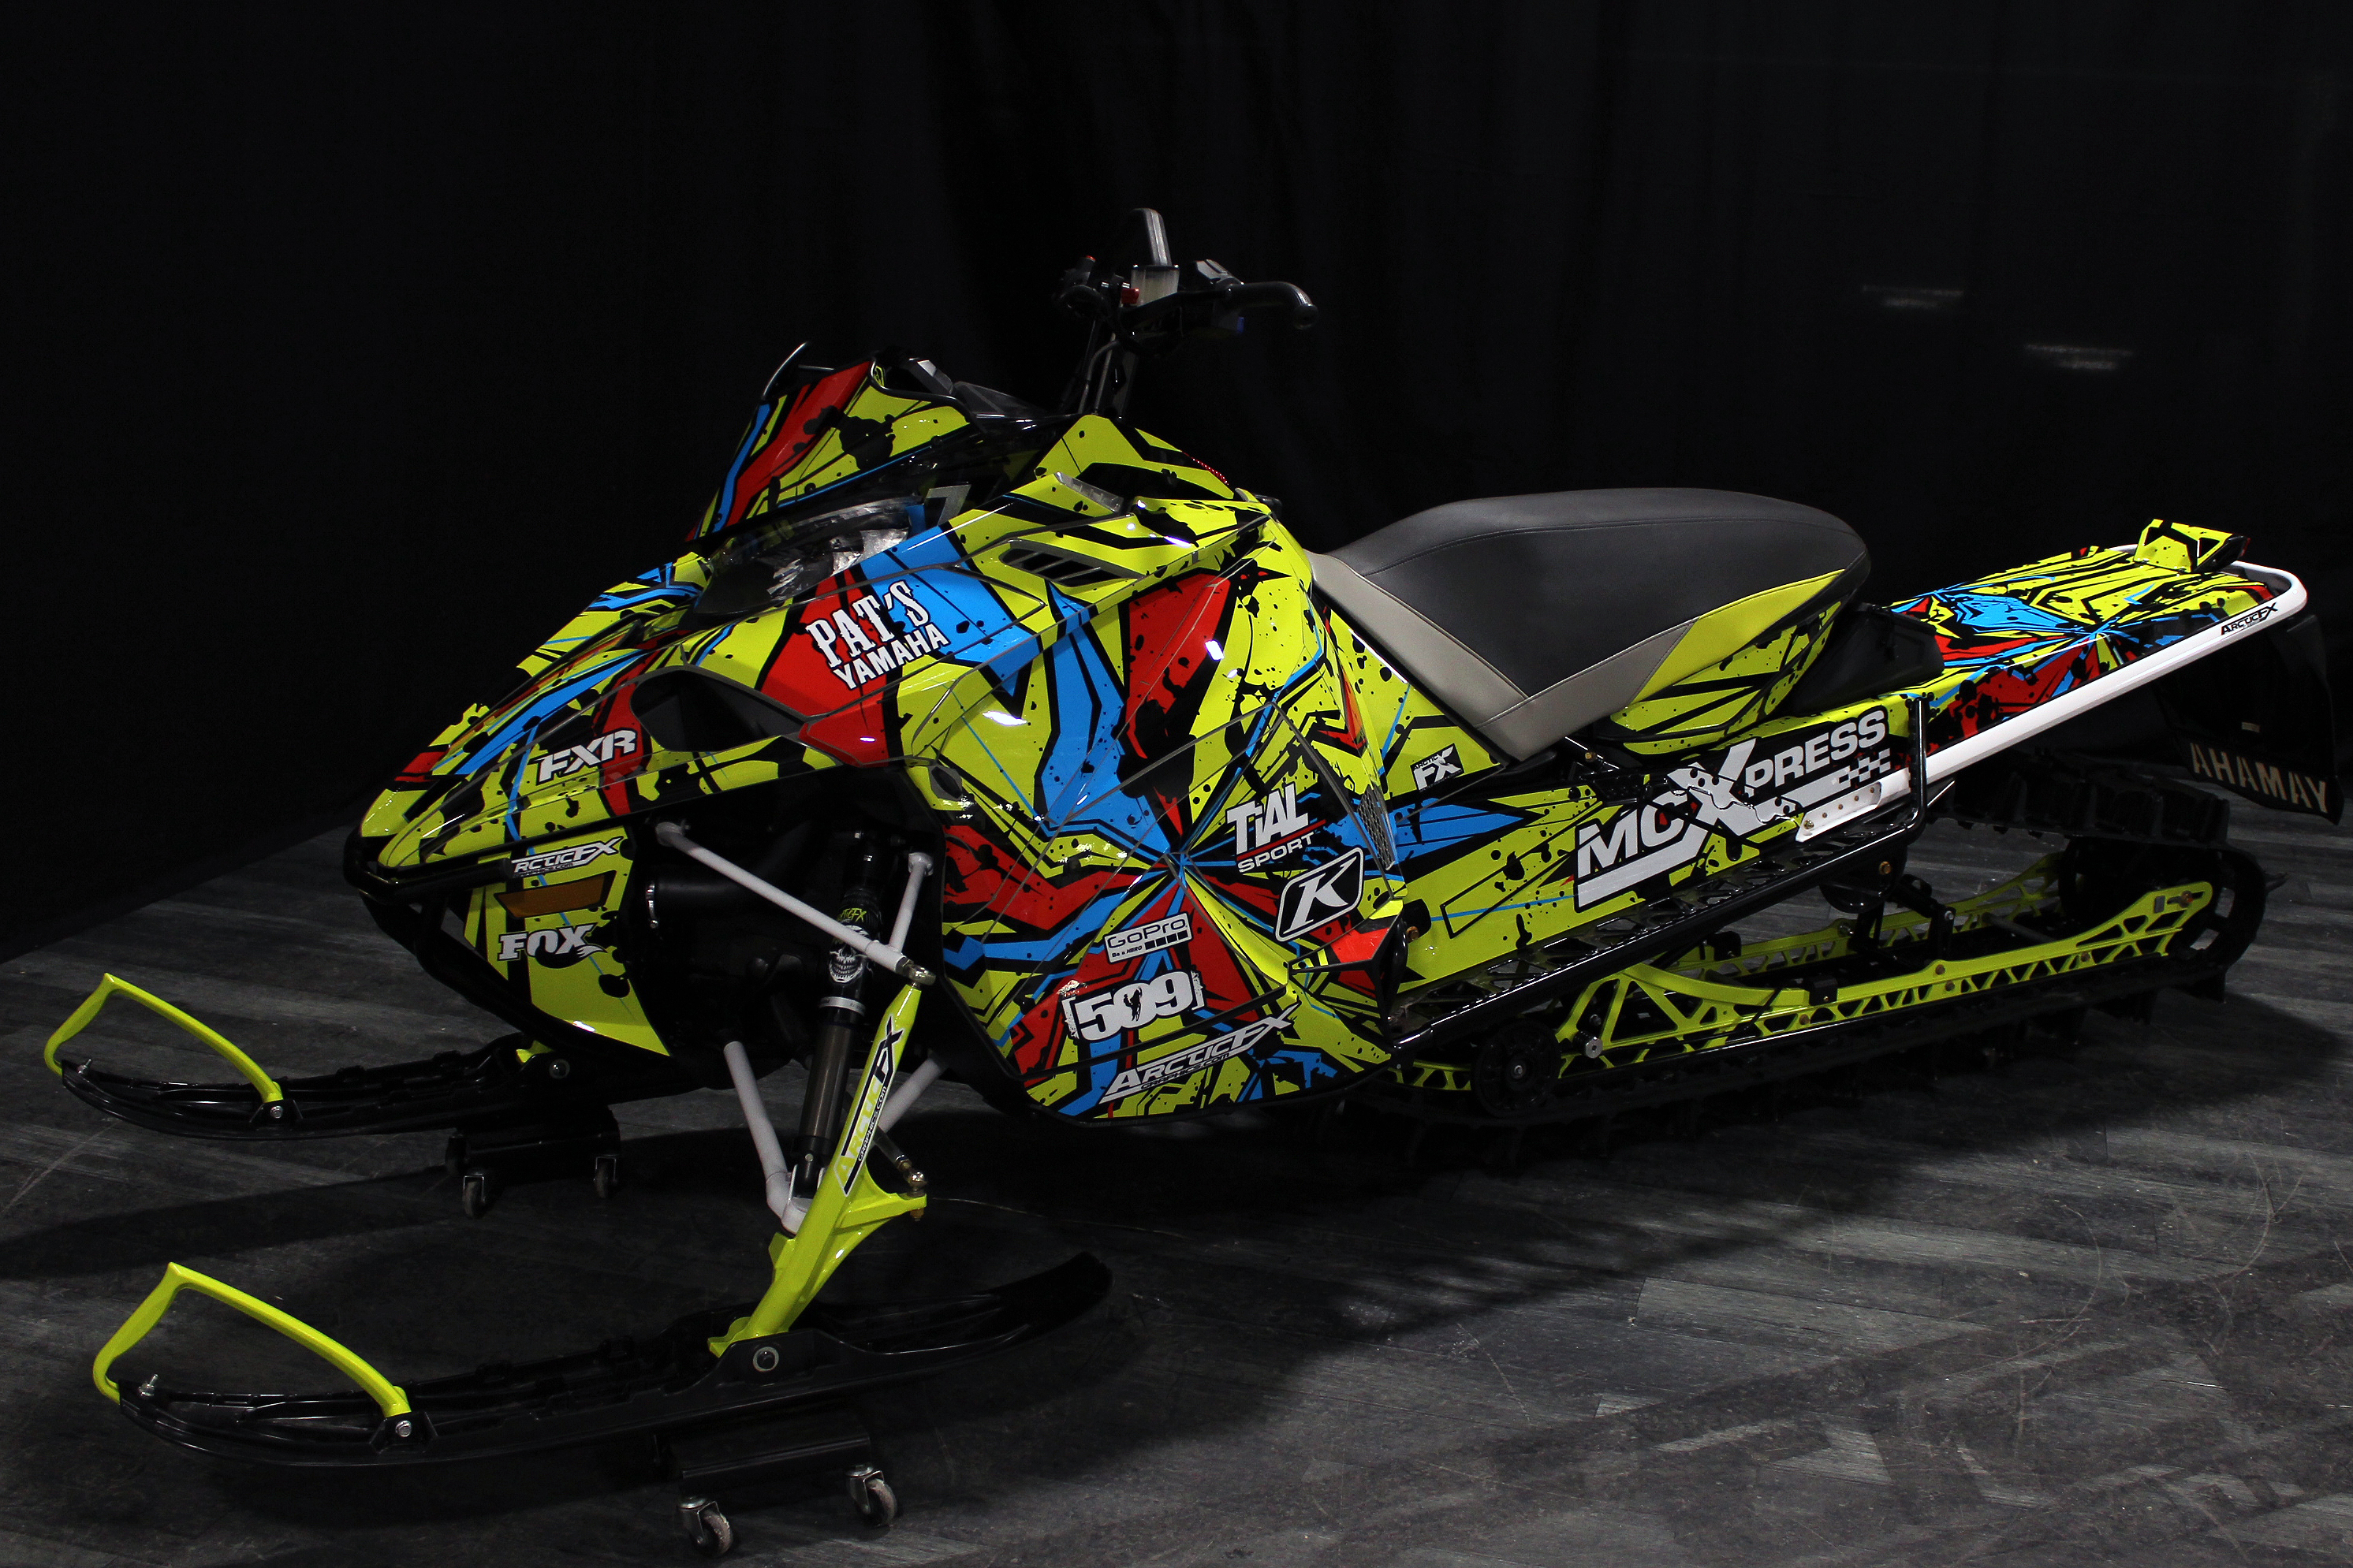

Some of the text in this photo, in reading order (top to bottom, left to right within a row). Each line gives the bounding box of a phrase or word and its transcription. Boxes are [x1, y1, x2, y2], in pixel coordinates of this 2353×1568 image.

[805, 580, 930, 668] PAT'S
[833, 624, 950, 690] YAMAHA
[532, 730, 636, 783] FXR
[1414, 746, 1462, 790] FX
[511, 836, 624, 873] RCTICFX
[1238, 832, 1314, 873] SPORT
[1282, 856, 1357, 934] K
[498, 923, 597, 962] FOX
[1107, 918, 1187, 948] GoPro
[1099, 1004, 1300, 1104] ARCTICFX
